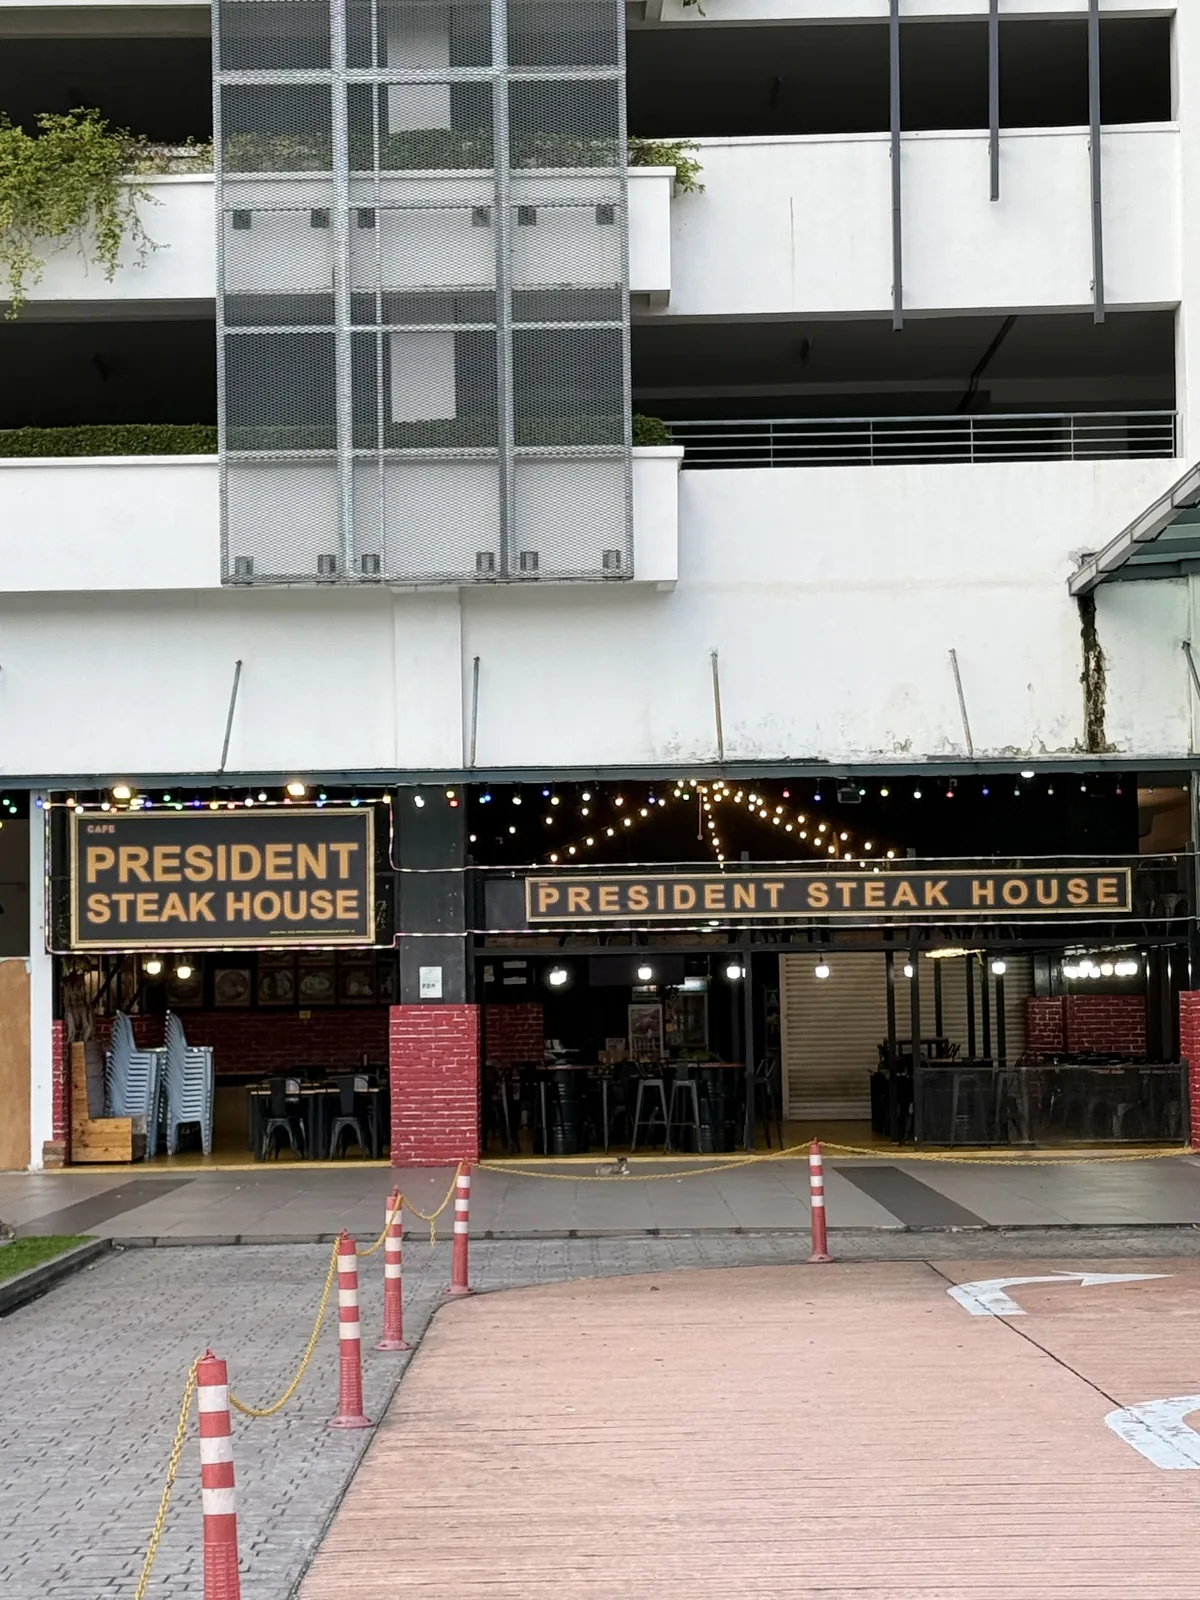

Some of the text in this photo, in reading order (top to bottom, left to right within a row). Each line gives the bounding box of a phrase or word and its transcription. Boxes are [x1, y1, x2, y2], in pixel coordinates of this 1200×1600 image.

[87, 825, 116, 834] CAFE
[87, 843, 359, 883] PRESIDENT
[87, 890, 359, 923] STEAK HOUSE
[538, 878, 1119, 912] PRESIDENT STEAK HOUSE
